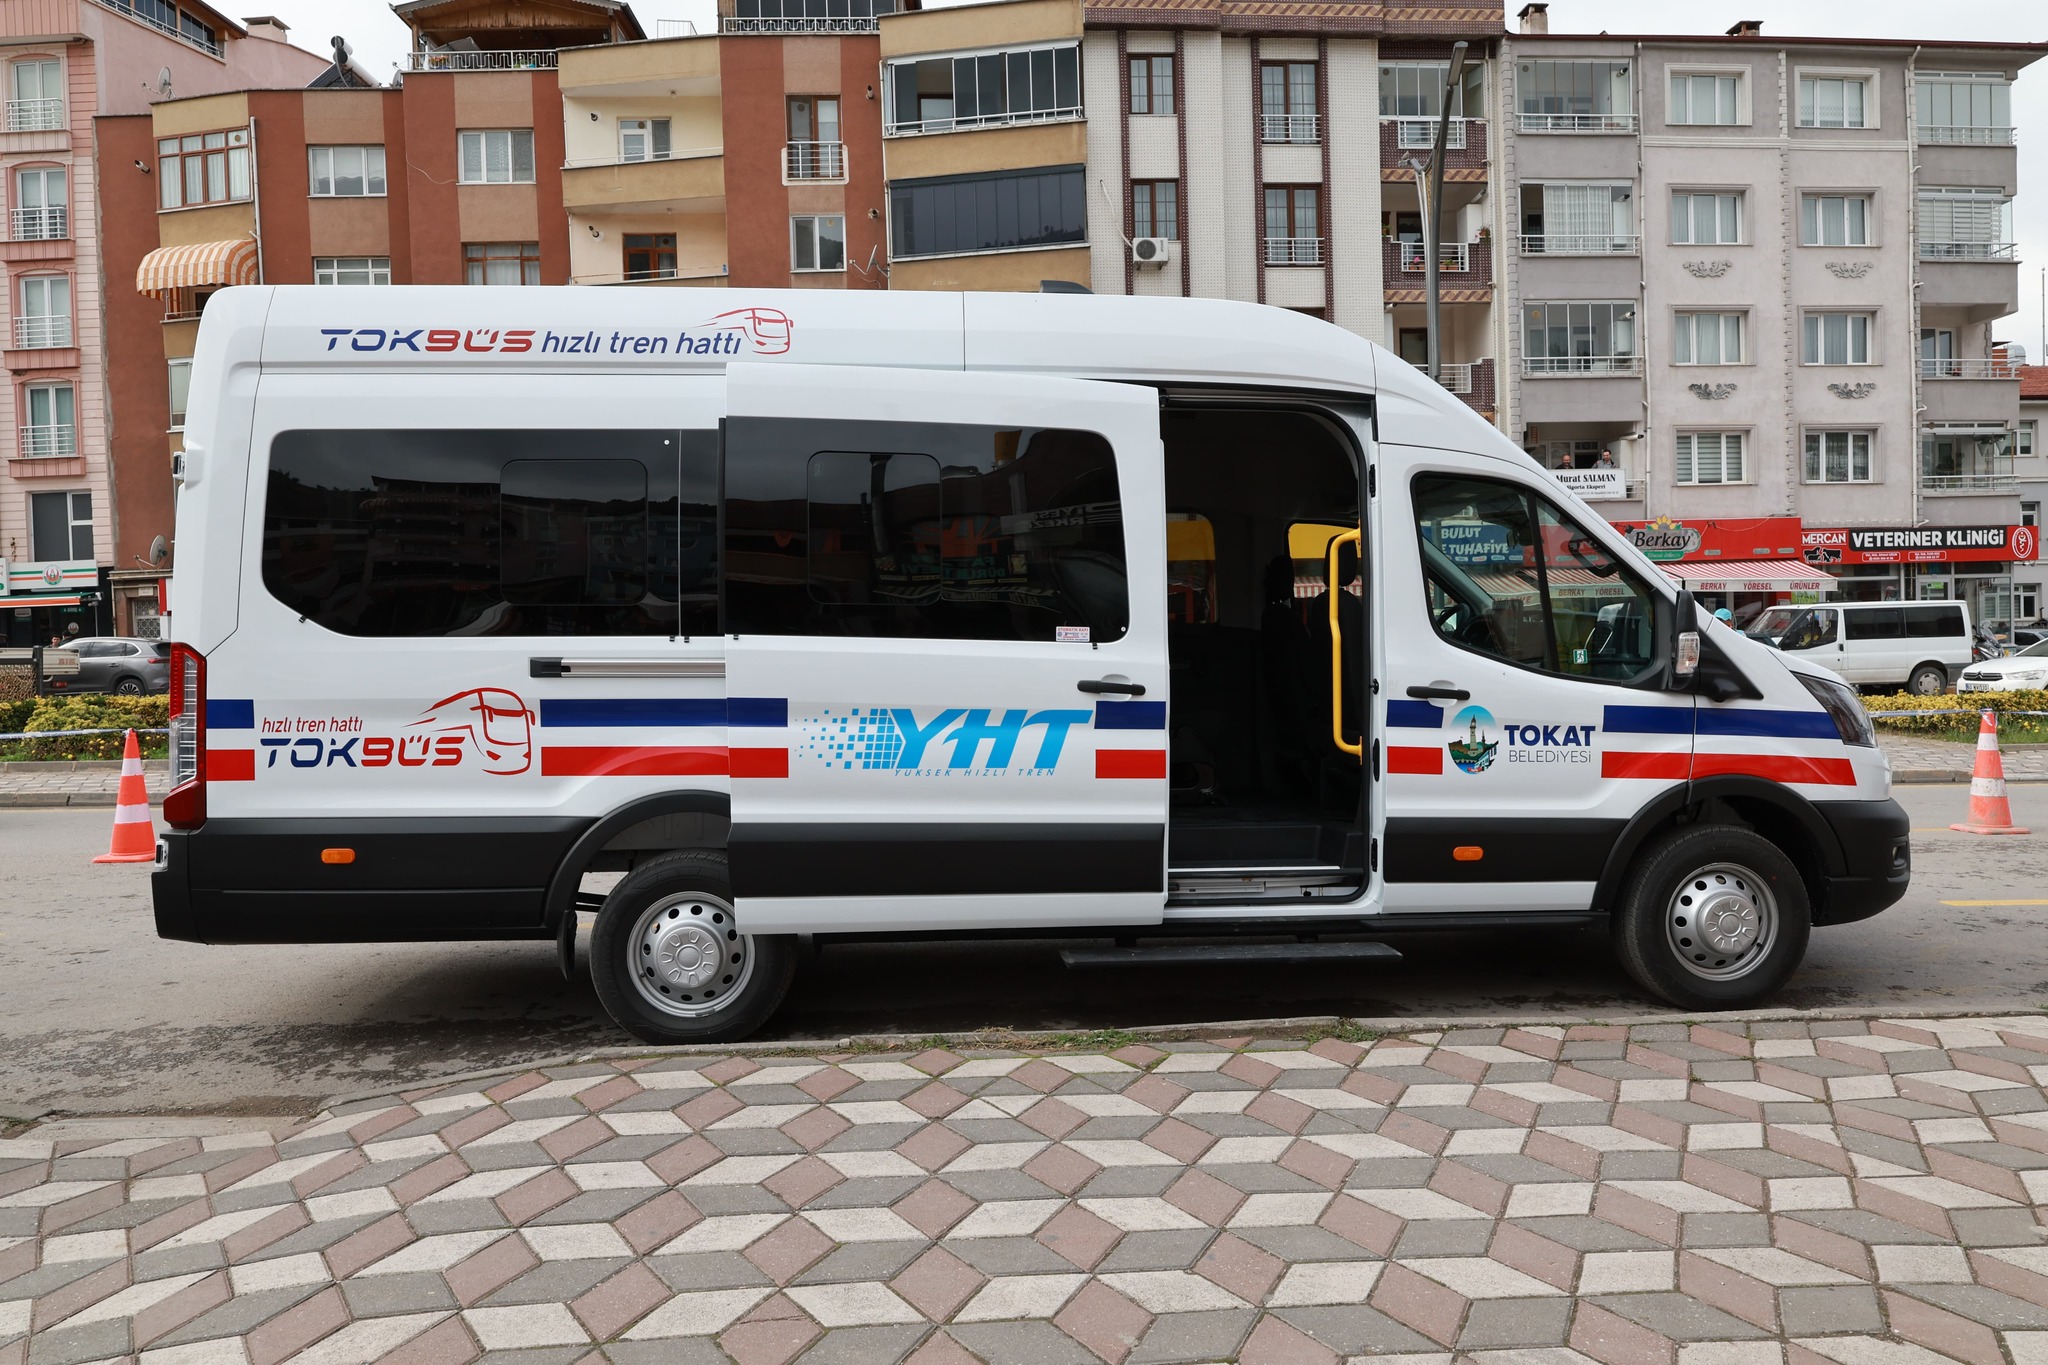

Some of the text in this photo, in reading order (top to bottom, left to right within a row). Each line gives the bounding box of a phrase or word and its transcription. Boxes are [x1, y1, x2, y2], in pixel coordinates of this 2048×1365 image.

[321, 329, 742, 354] TOKBÜS hızlı tren hattı
[1556, 474, 1616, 483] Murat SALMAN
[1441, 527, 1481, 539] BULUT
[1634, 531, 1690, 550] Berkay
[1802, 532, 1846, 545] MERCAN
[1449, 539, 1509, 555] TUHAFİYE
[1558, 587, 1624, 597] BERKAY YÖRESEL
[1700, 580, 1820, 591] BERKAY YÖRESEL ÜRÜNLER
[261, 717, 363, 733] hızlı tren hattı
[890, 708, 1093, 769] YHT
[1504, 725, 1596, 747] TOKAT
[260, 735, 465, 768] TOKBÜS
[964, 768, 1006, 777] HIZLI
[1018, 768, 1056, 777] TREN
